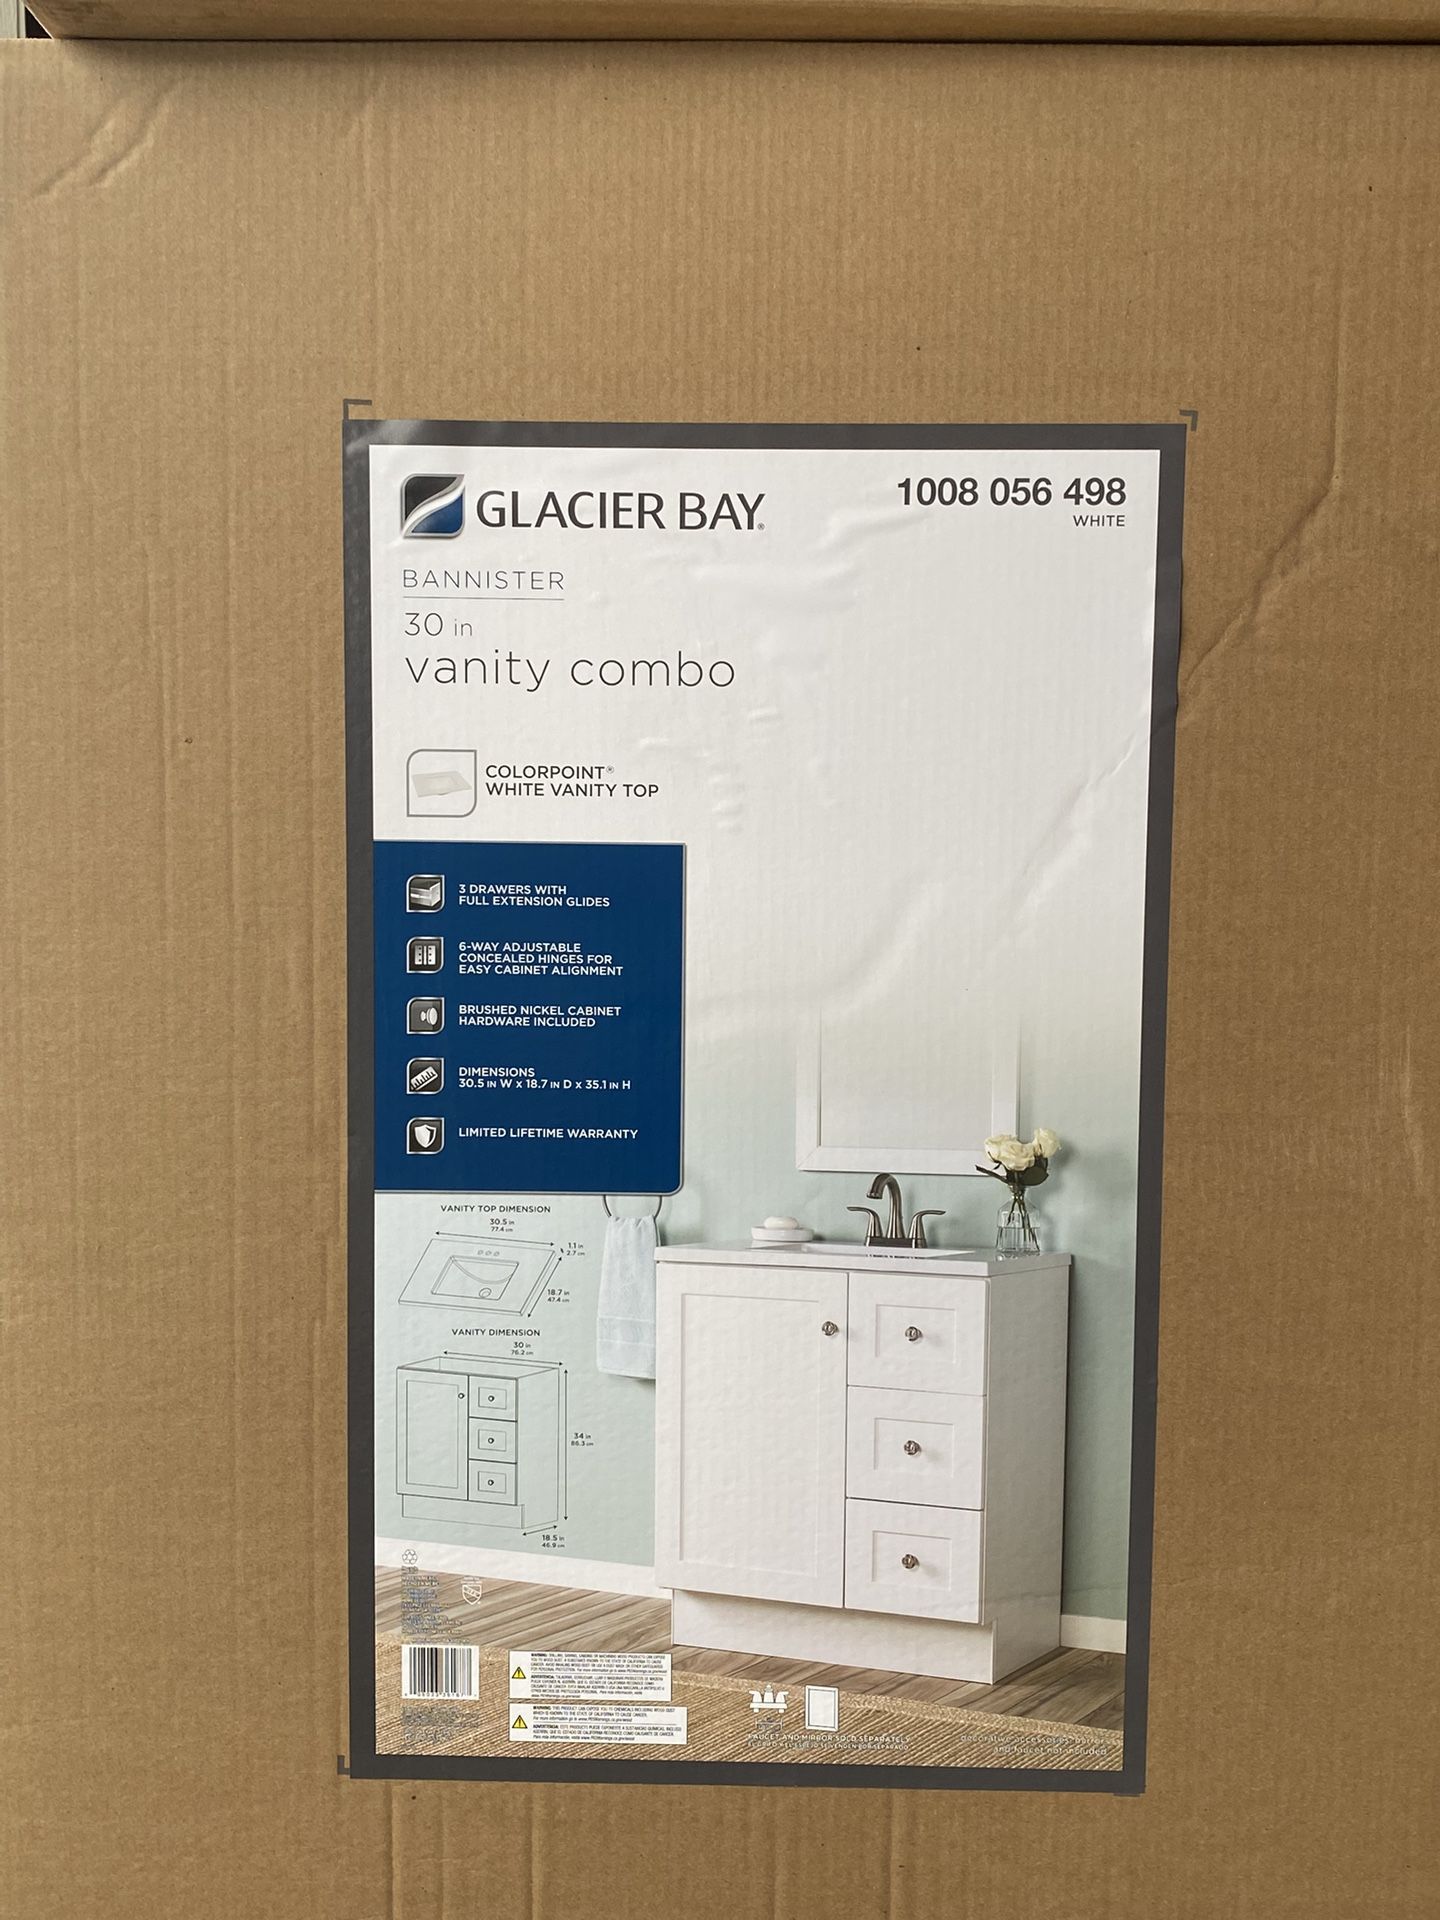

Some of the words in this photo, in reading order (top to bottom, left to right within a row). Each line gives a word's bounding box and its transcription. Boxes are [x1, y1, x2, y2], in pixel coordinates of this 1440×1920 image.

[898, 478, 978, 505] 1008
[990, 478, 1052, 505] 056
[1064, 478, 1126, 505] 498
[477, 491, 665, 529] GLACIER
[1073, 515, 1125, 526] WHITE
[404, 570, 563, 590] BANNISTER
[405, 613, 443, 636] 30
[455, 619, 472, 636] in
[405, 649, 549, 692] vanity
[571, 651, 734, 687] combo
[486, 783, 544, 796] WHITE
[551, 783, 617, 797] VANITY
[623, 784, 658, 797] TOP
[459, 884, 465, 893] 3
[470, 885, 531, 894] DRAWERS
[535, 885, 566, 894] WITH
[459, 896, 489, 905] FULL
[493, 896, 562, 906] EXTENSION
[566, 897, 609, 907] GLIDES
[459, 942, 499, 951] 6-WAY
[503, 943, 581, 952] ADJUSTABLE
[459, 953, 534, 963] CONCEALED
[539, 954, 583, 963] HINGES
[588, 955, 612, 964] FOR
[459, 965, 491, 974] EASY
[495, 965, 548, 974] CABINET
[552, 966, 623, 975] ALIGNMENT
[459, 1005, 517, 1014] BRUSHED
[521, 1006, 564, 1015] NICKEL
[568, 1006, 621, 1016] CABINET
[459, 1016, 530, 1026] HARDWARE
[534, 1017, 595, 1027] INCLUDED
[459, 1067, 535, 1077] DIMENSIONS
[459, 1078, 484, 1087] 30.5
[500, 1079, 512, 1088] W
[526, 1079, 548, 1088] 18.7
[564, 1080, 572, 1088] D
[586, 1080, 606, 1089] 35.1
[623, 1080, 630, 1089] H
[459, 1128, 506, 1137] LIMITED
[510, 1128, 563, 1138] LIFETIME
[567, 1129, 638, 1138] WARRANTY
[440, 1204, 475, 1212] VANITY
[477, 1205, 498, 1213] TOP
[498, 1205, 551, 1214] DIMENSION
[489, 1218, 508, 1226] 30.5
[567, 1241, 577, 1249] 1.1
[451, 1328, 487, 1336] VANITY
[488, 1328, 541, 1337] DIMENSION
[513, 1341, 525, 1349] 30
[574, 1432, 584, 1440] 34
[541, 1534, 558, 1542] 18.5
